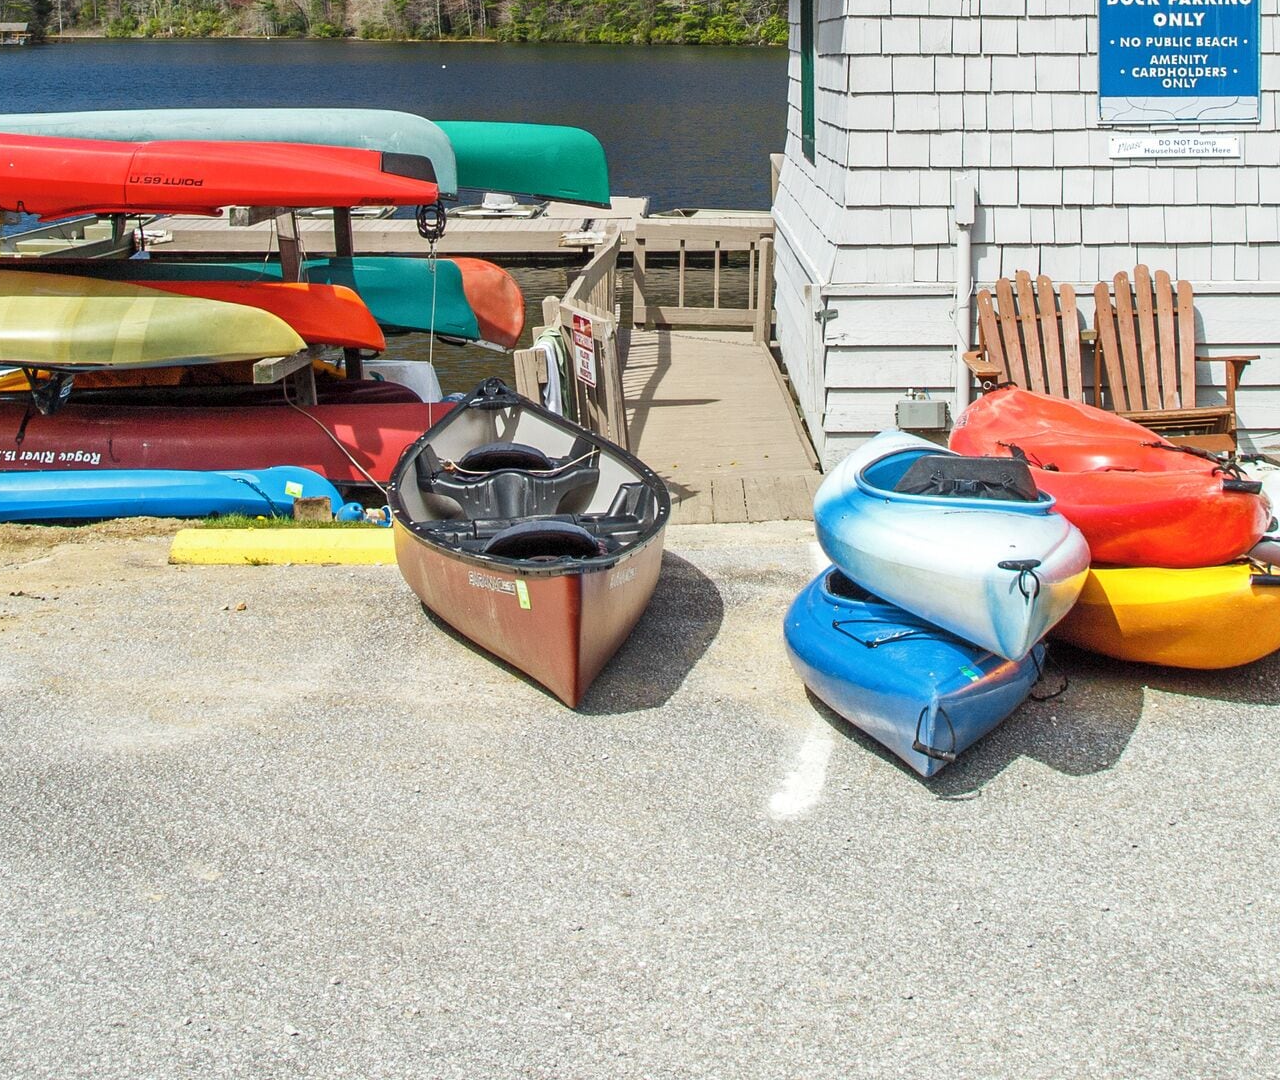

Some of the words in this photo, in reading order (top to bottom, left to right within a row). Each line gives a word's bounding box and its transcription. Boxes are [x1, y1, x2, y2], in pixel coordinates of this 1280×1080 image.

[1152, 12, 1206, 27] ONLY
[1120, 37, 1141, 48] NO
[1145, 36, 1192, 48] PUBLIC
[1196, 36, 1238, 47] BEACH
[1150, 54, 1208, 65] AMENITY
[1131, 66, 1228, 78] CARDHOLDERS
[1161, 78, 1197, 88] ONLY
[1193, 139, 1217, 147] Dump
[162, 177, 204, 187] POINT
[19, 450, 55, 463] River
[59, 450, 101, 465] Rogue
